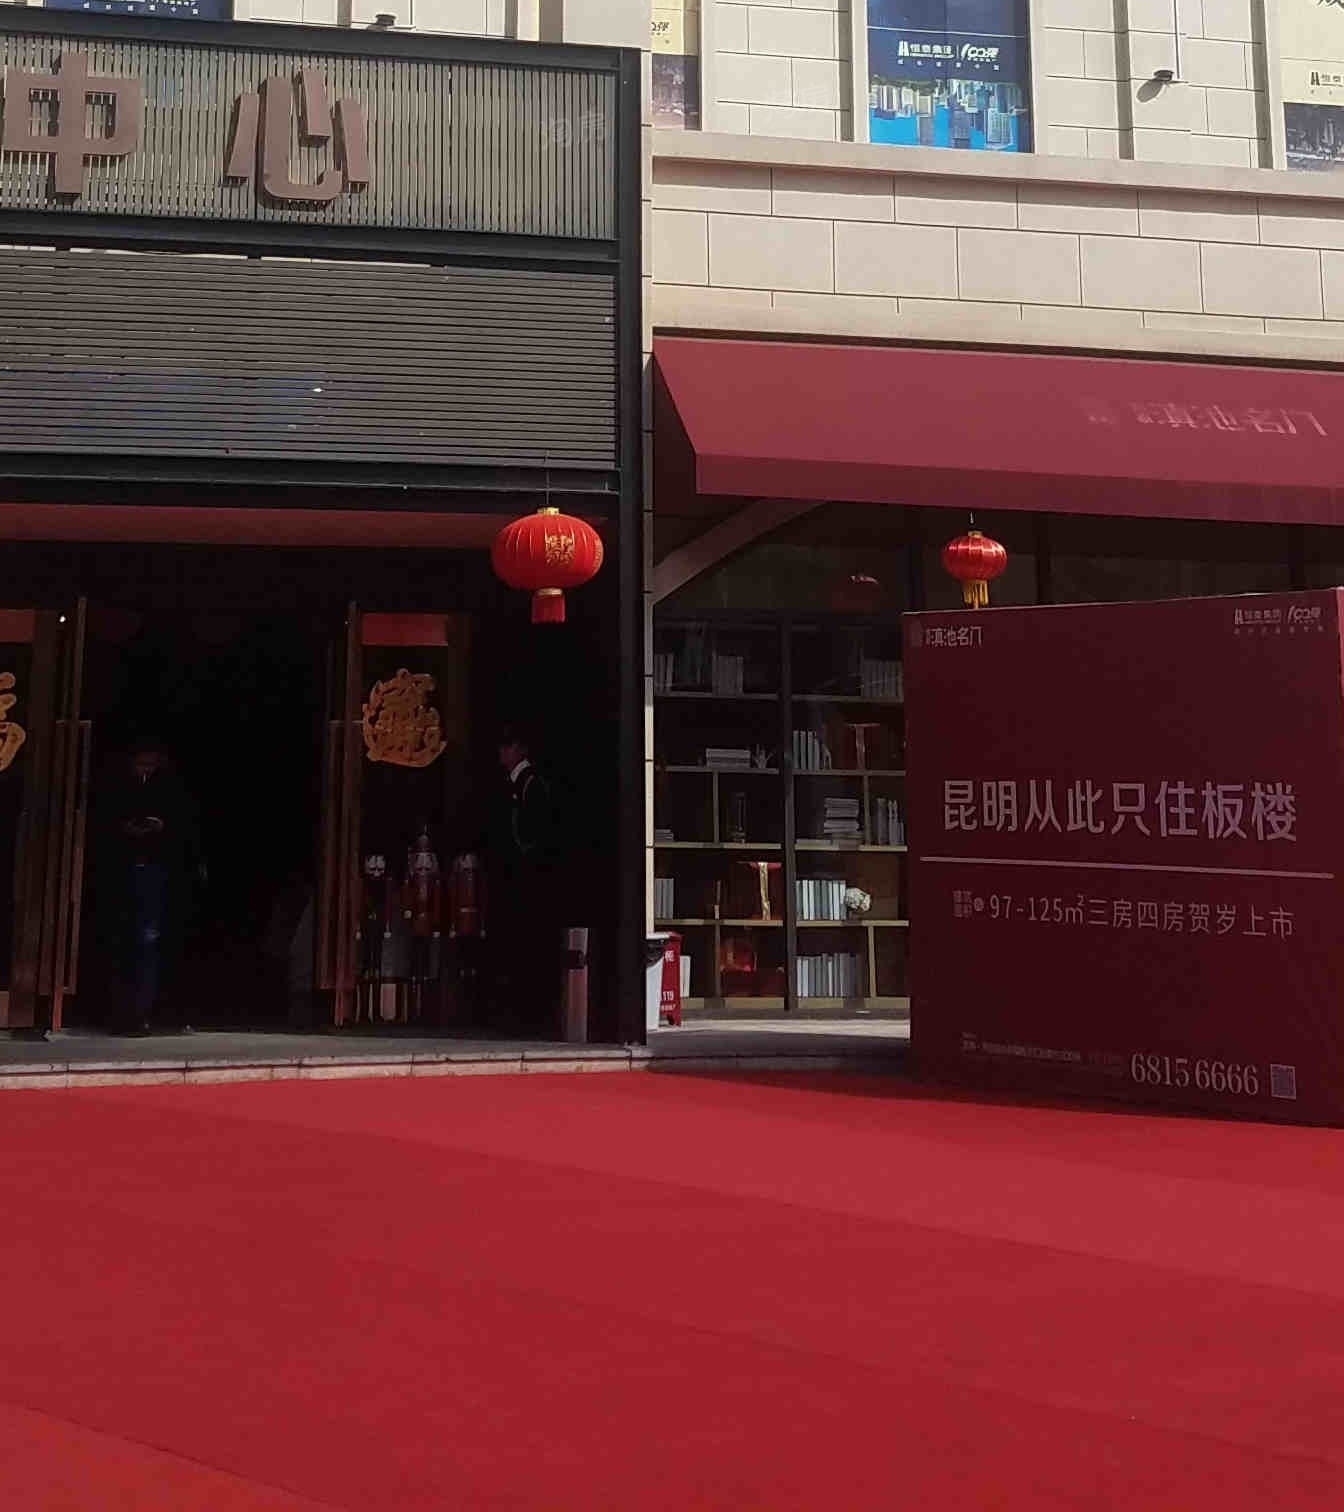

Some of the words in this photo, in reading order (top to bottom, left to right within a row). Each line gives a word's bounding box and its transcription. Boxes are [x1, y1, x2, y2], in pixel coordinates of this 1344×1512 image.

[943, 779, 1297, 843] 昆明从此只住板楼
